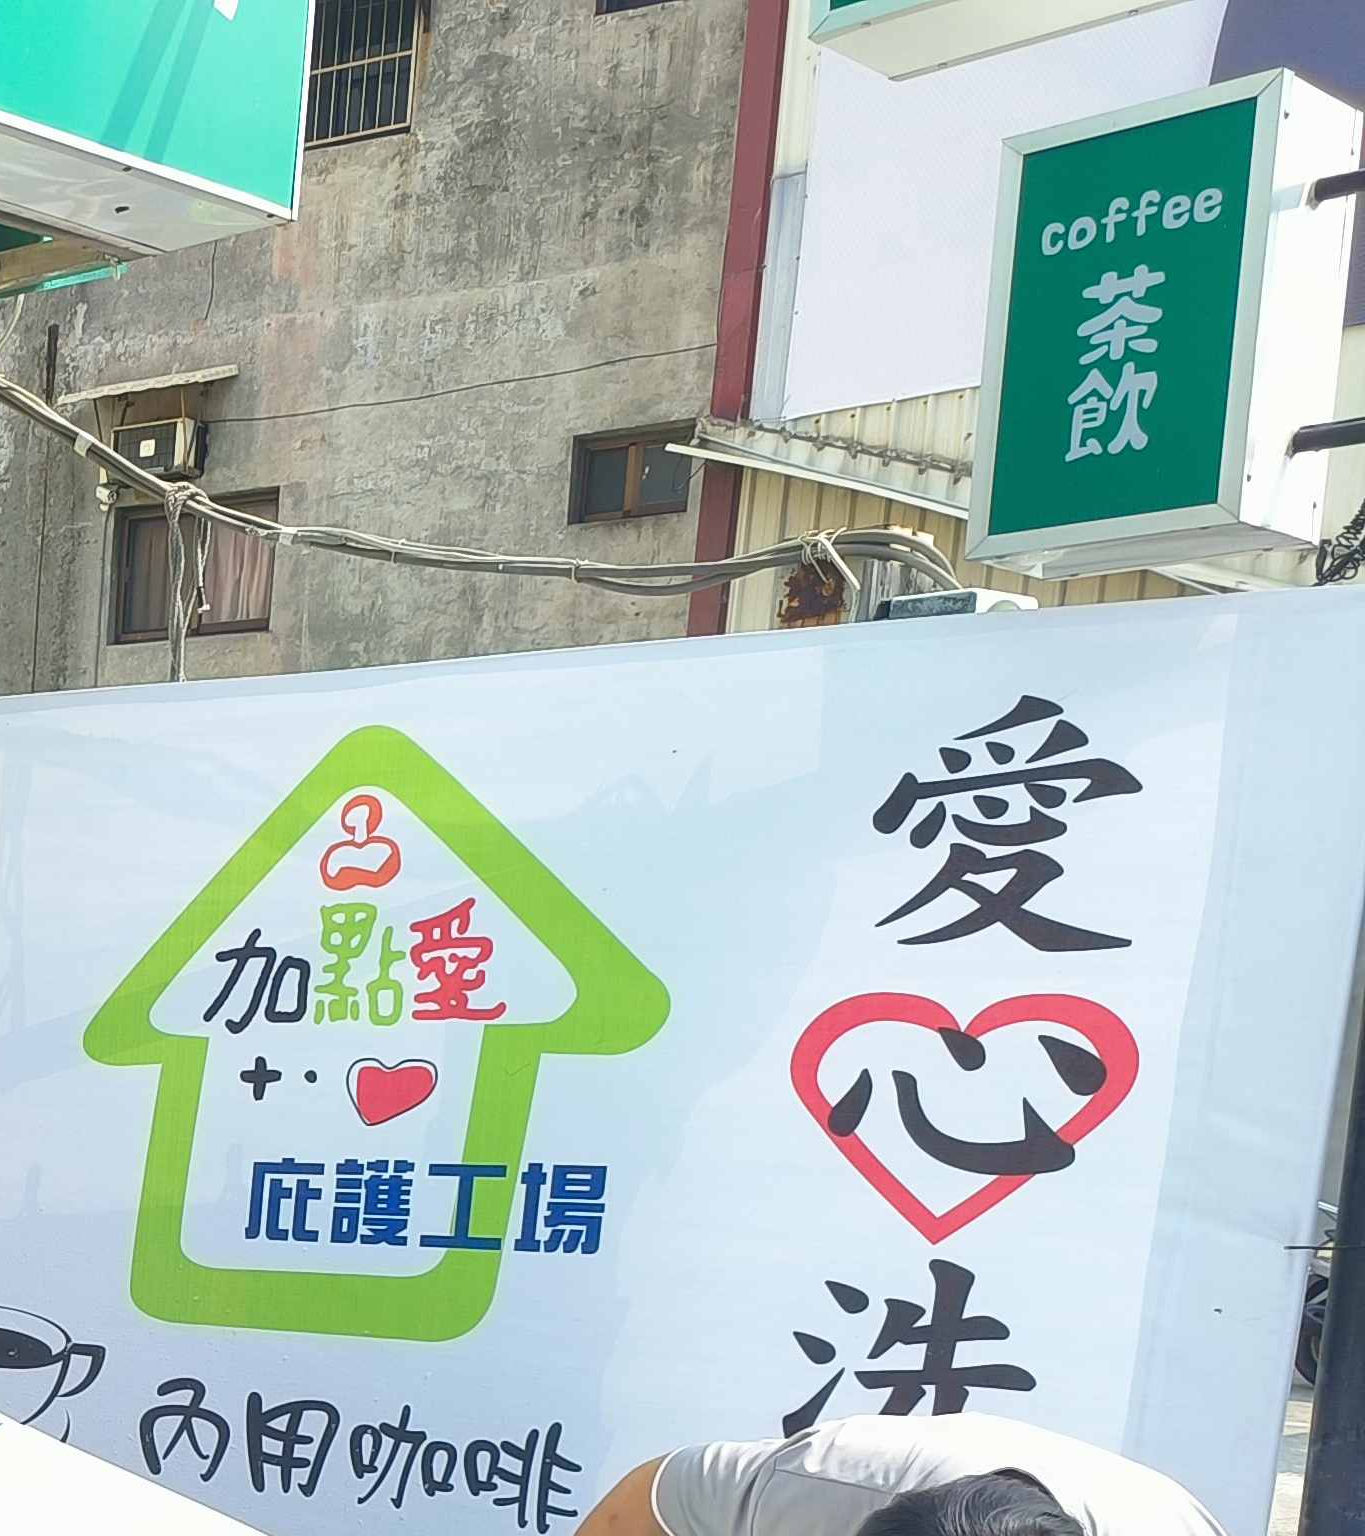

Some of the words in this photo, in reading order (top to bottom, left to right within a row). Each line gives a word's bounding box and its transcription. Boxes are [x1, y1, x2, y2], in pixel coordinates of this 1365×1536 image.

[1041, 187, 1223, 256] coffee
[1064, 263, 1166, 463] 茶飲
[202, 897, 507, 1035] 加點愛
[244, 1157, 609, 1255] 庇護工場
[139, 1377, 584, 1535] 內用咖啡
